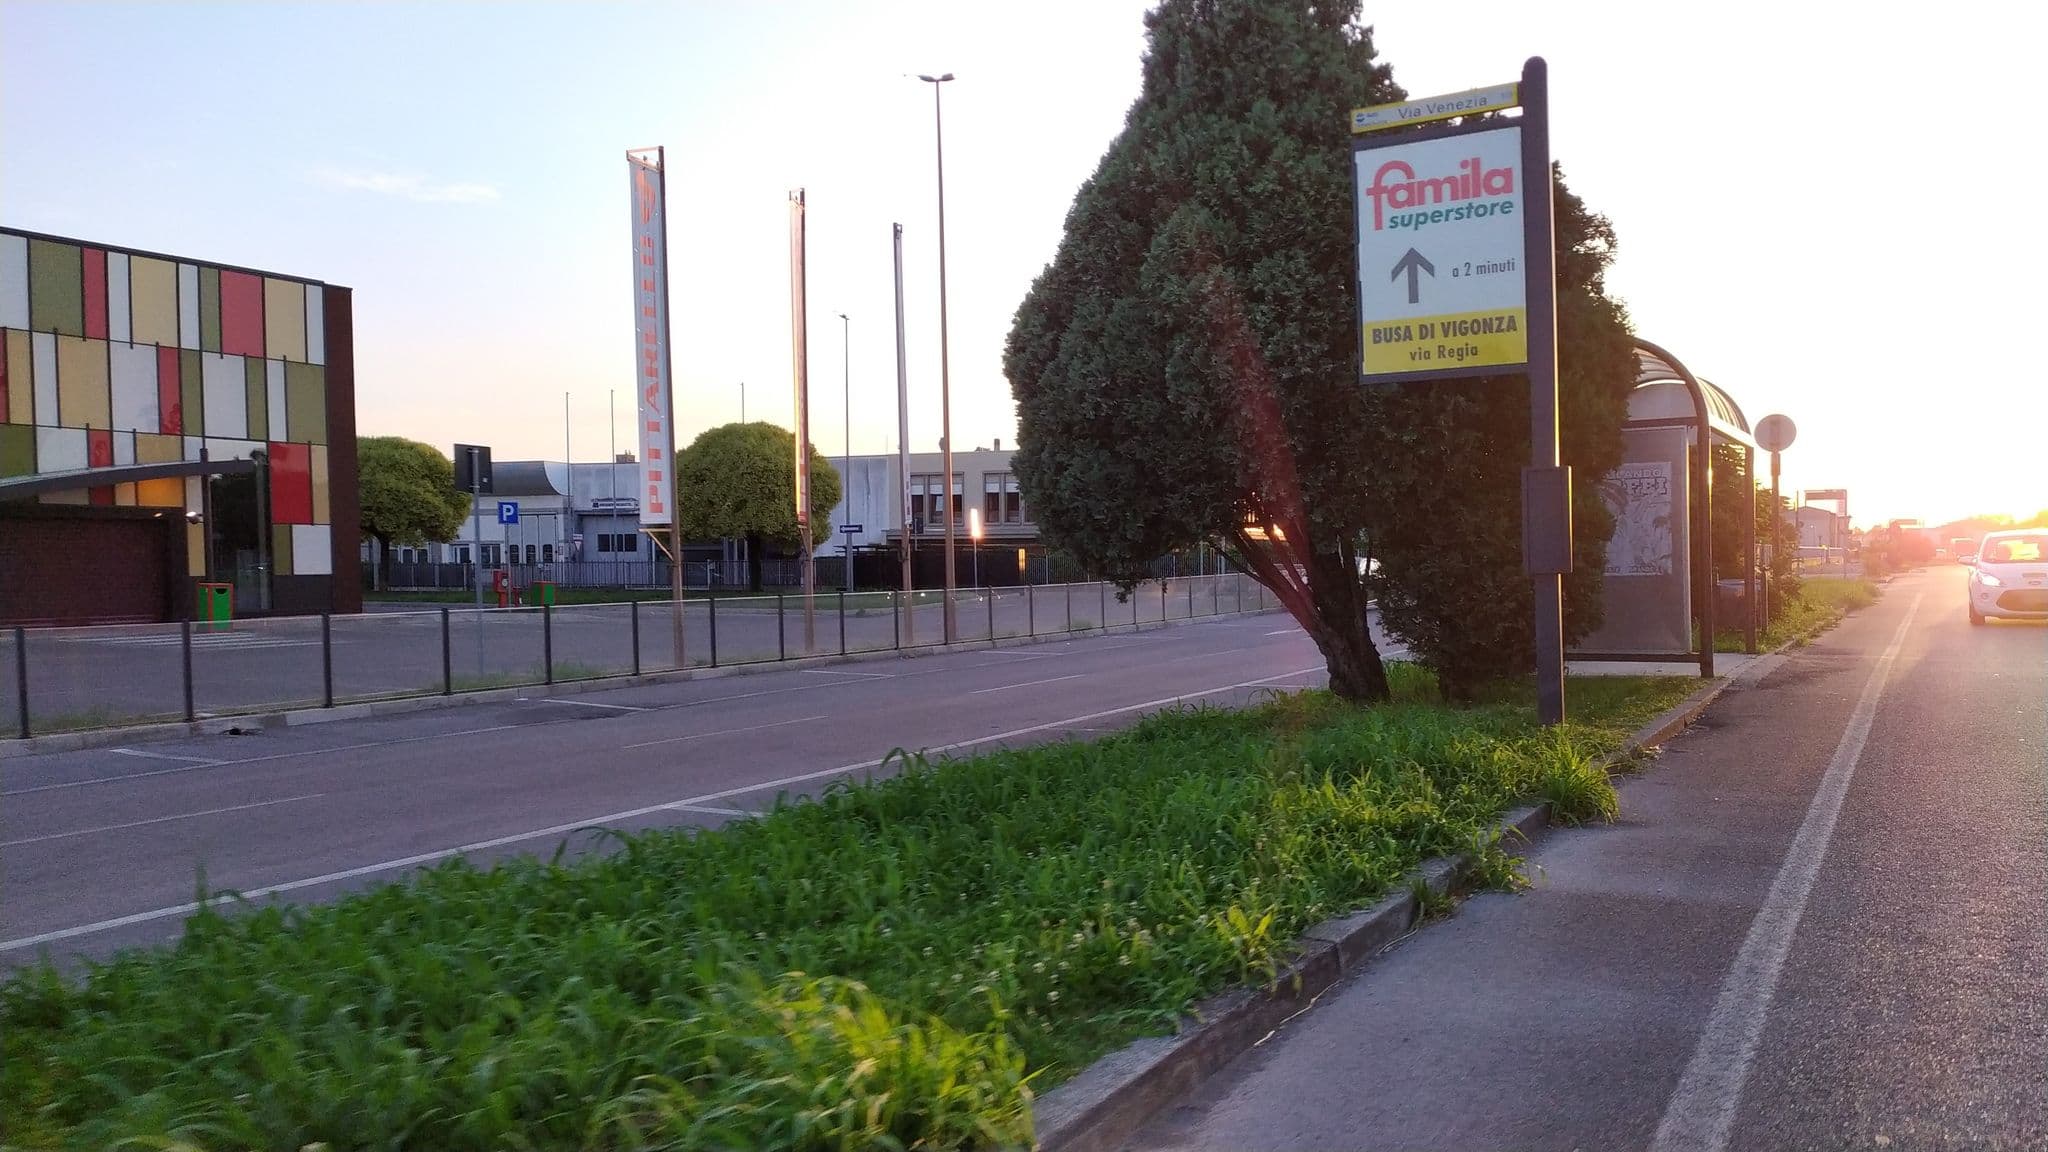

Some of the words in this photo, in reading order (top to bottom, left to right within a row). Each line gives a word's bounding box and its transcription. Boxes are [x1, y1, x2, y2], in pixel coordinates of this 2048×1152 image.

[1397, 105, 1421, 120] Via
[1426, 95, 1488, 116] Venezia
[1366, 157, 1514, 231] famila
[1388, 199, 1514, 231] superstore
[1452, 267, 1460, 278] a
[1464, 261, 1472, 277] 2
[1476, 258, 1516, 276] minuti
[1371, 325, 1413, 345] BUSA
[1418, 323, 1436, 341] DI
[1440, 314, 1518, 339] VIGONZA
[1409, 346, 1432, 362] via
[1437, 343, 1479, 362] Regia
[502, 504, 515, 522] P
